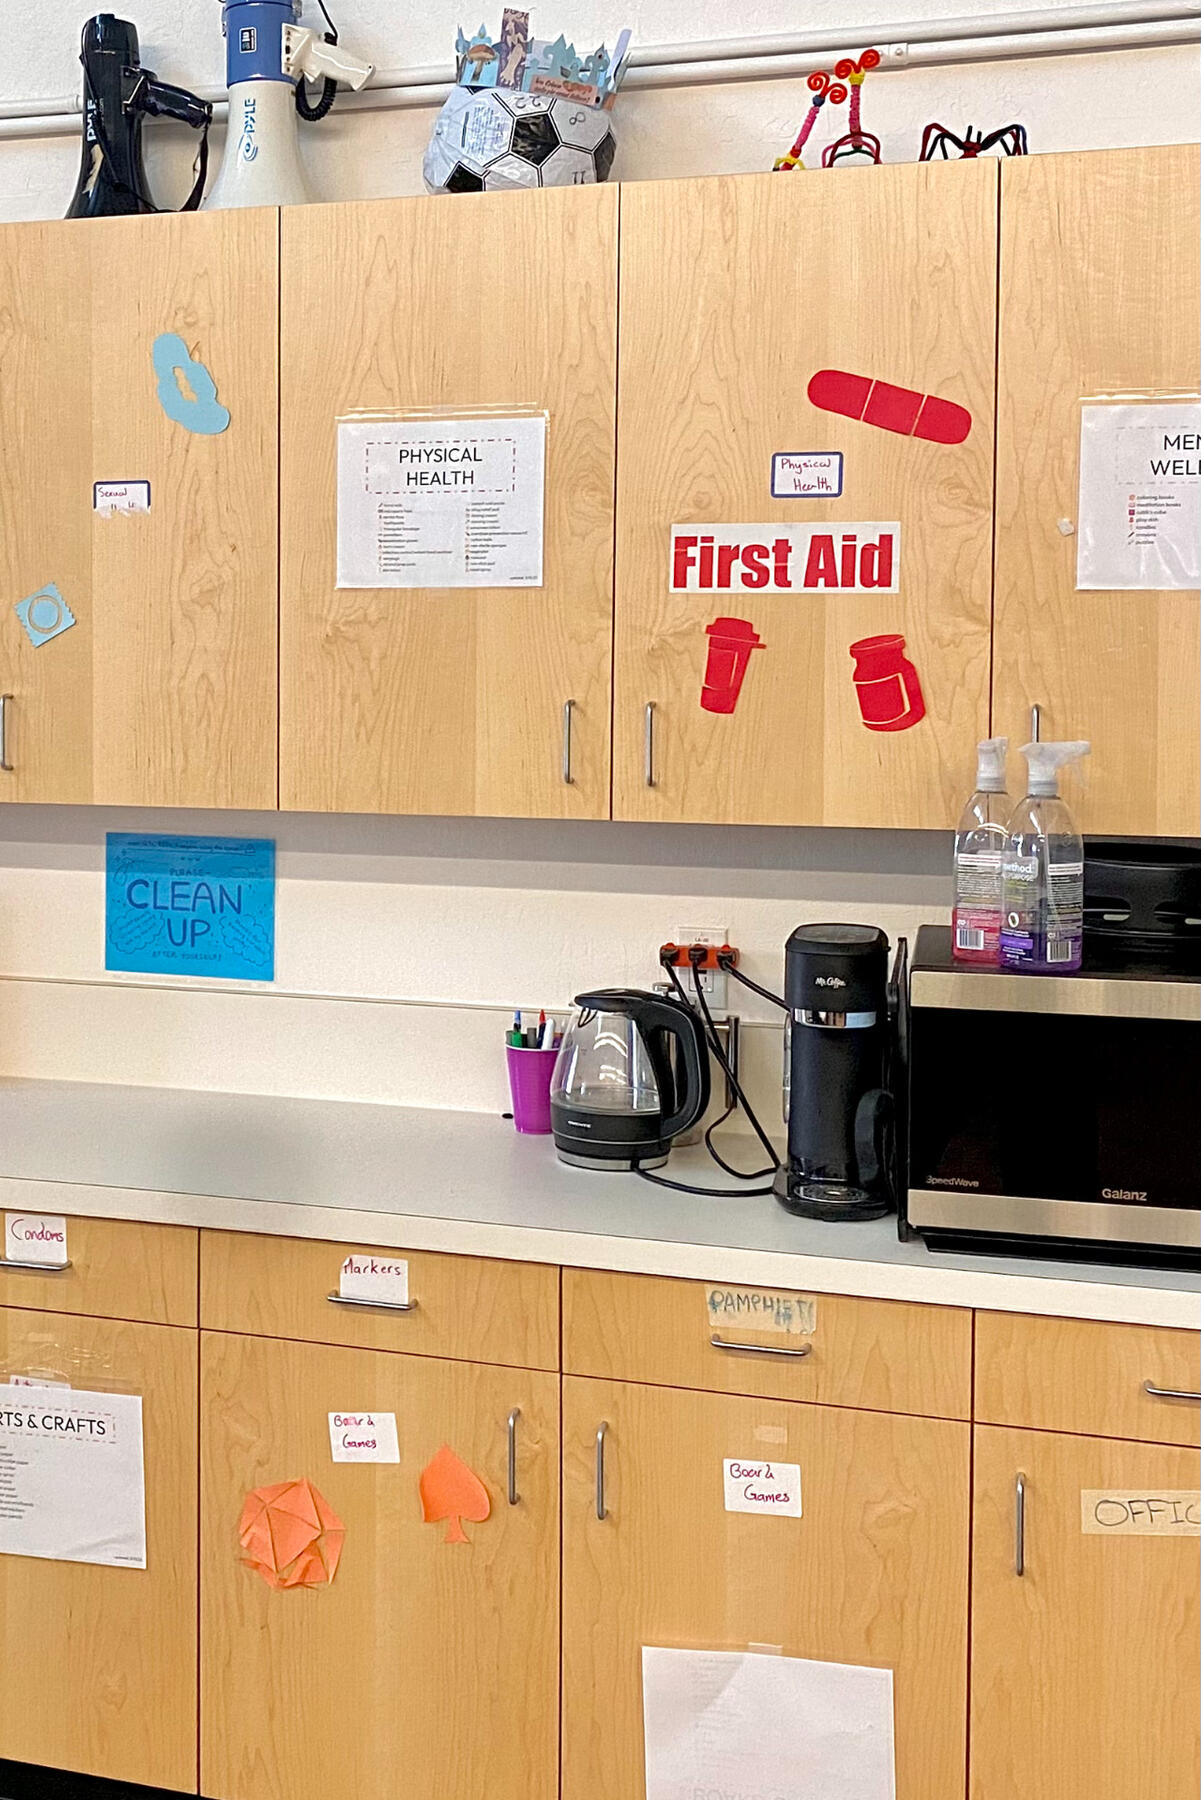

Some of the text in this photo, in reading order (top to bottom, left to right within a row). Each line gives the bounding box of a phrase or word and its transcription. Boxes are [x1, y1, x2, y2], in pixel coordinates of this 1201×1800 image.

[243, 98, 257, 134] PYLE
[399, 446, 483, 464] PHYSICAL
[781, 457, 832, 474] Physical
[406, 470, 475, 487] HEALTH
[673, 534, 893, 589] First Aid
[126, 879, 242, 915] CLEAN
[167, 918, 211, 948] UP
[925, 1175, 979, 1188] SpeedWave
[1101, 1188, 1147, 1201] Galanz
[11, 1218, 64, 1243] Condoms
[343, 1257, 401, 1276] Markers
[27, 1413, 39, 1429] &
[41, 1414, 106, 1436] CRAFTS
[342, 1433, 377, 1449] Games
[743, 1483, 791, 1503] Games
